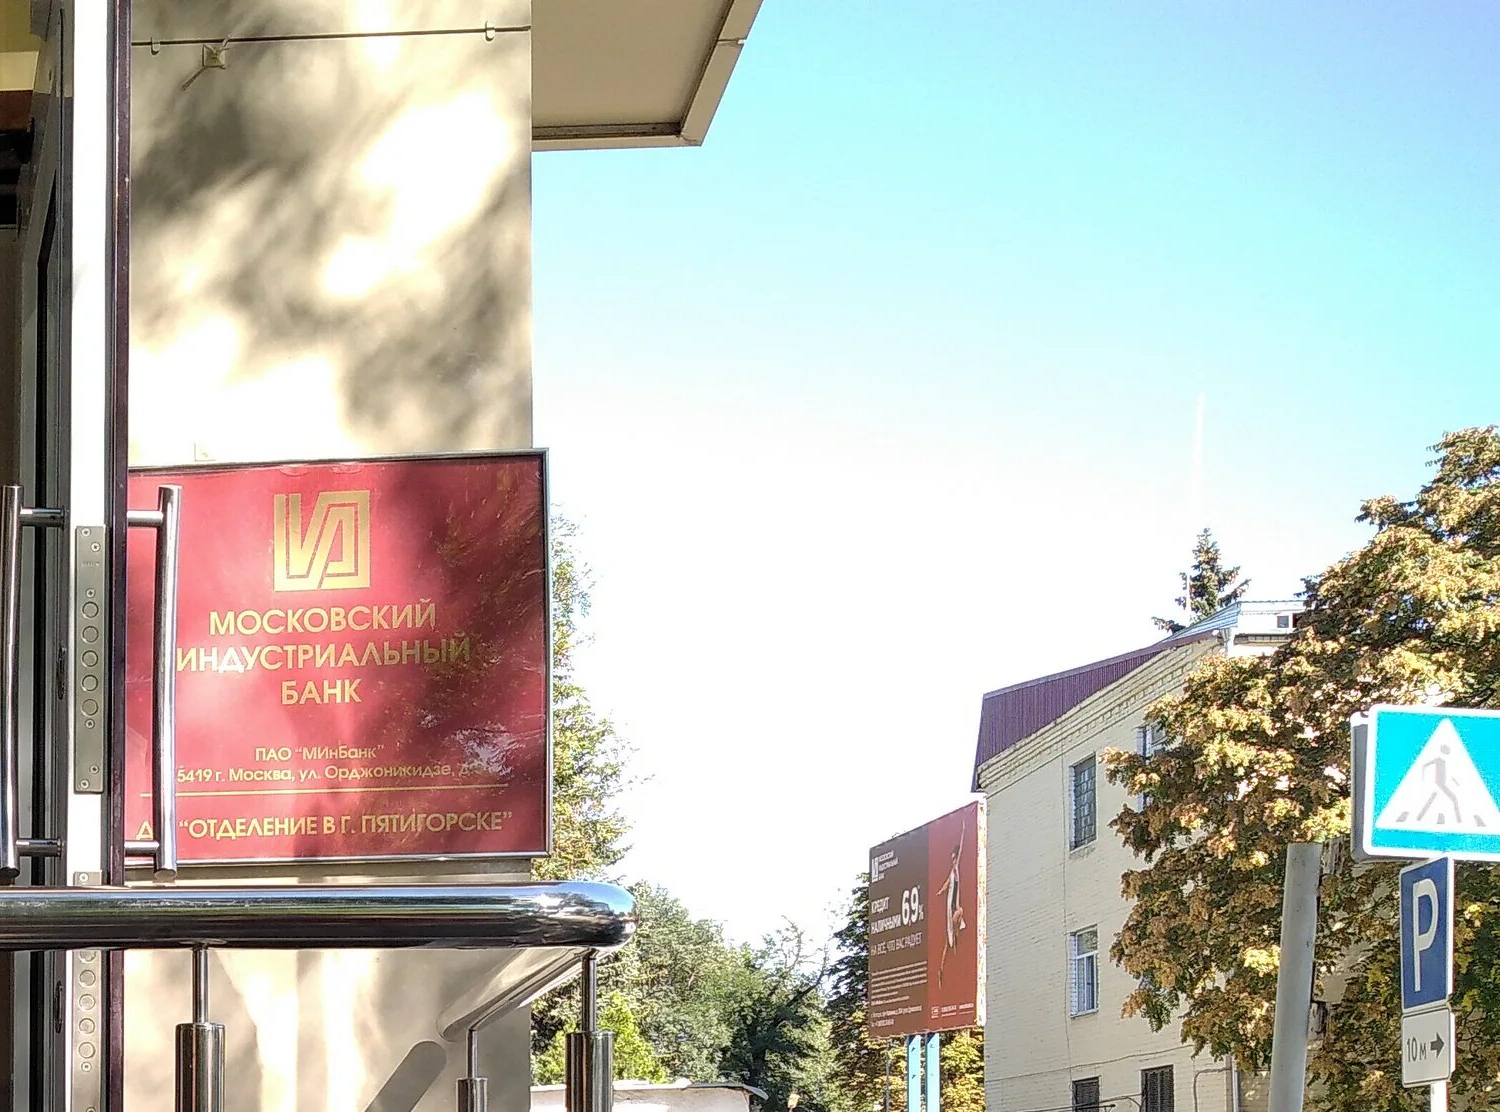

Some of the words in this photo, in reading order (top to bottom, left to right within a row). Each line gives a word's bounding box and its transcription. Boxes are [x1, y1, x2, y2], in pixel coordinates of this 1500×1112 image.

[209, 598, 437, 636] МОСКОВСКИЙ
[177, 631, 470, 673] ИНДУСТРИАЛЬНЫЙ
[281, 679, 362, 705] БАНК
[255, 747, 292, 762] ПАО
[177, 766, 213, 783] 5419
[215, 770, 226, 782] г.
[228, 767, 295, 782] Москва,
[299, 769, 321, 782] ул.
[324, 763, 455, 782] Орджоникидзе,
[323, 816, 336, 835] В
[341, 814, 356, 834] Г.
[1406, 1036, 1418, 1063] 10
